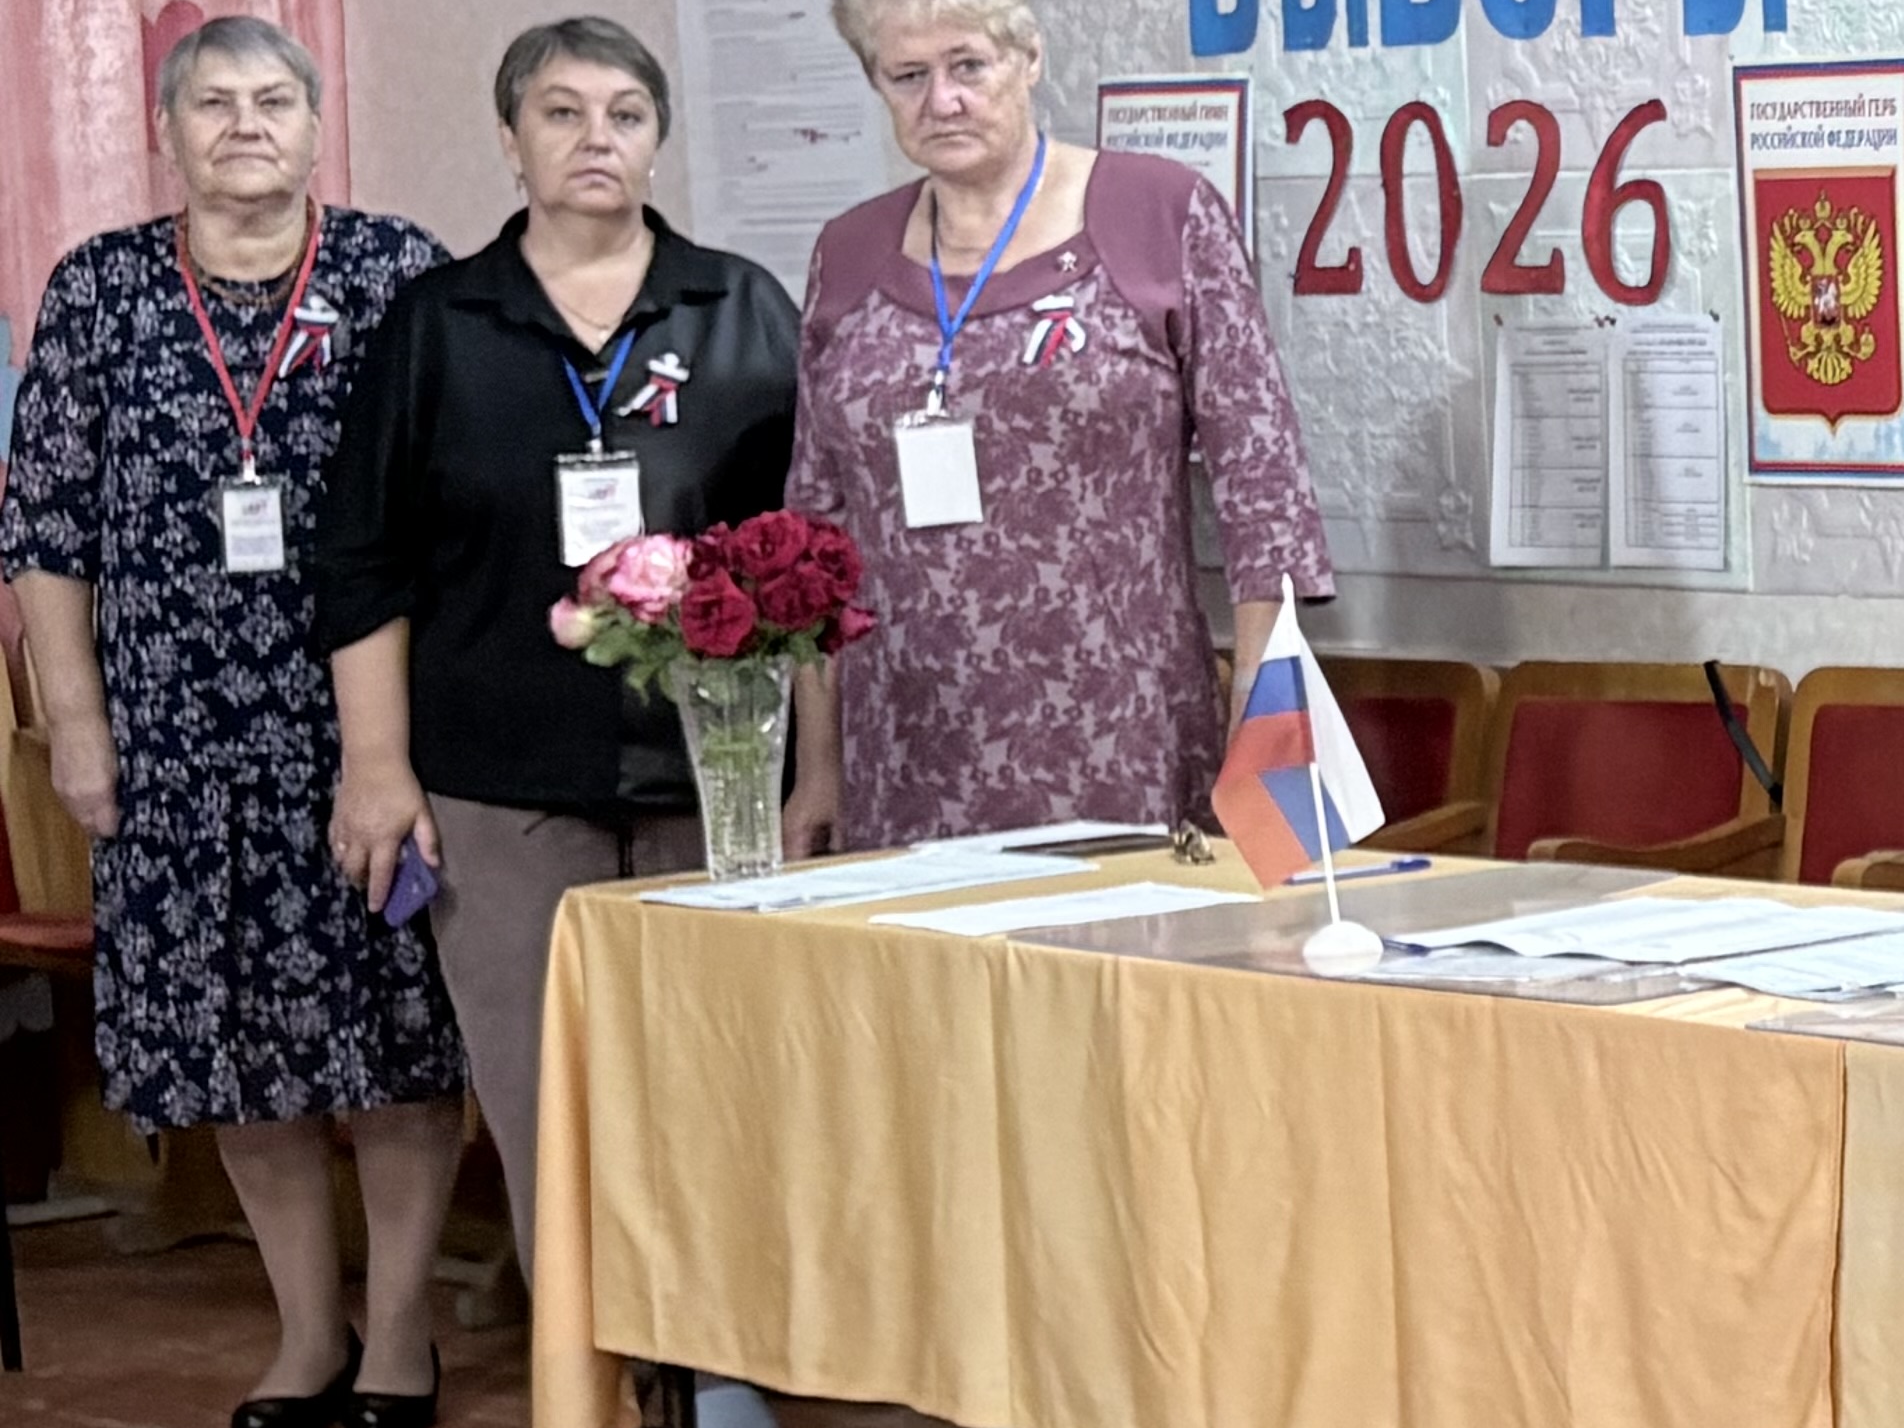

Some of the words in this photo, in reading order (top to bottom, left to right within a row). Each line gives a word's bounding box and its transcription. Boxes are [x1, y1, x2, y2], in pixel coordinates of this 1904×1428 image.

[1749, 93, 1866, 122] ГОСУДАРСТВЕННЫЙ
[1868, 98, 1897, 118] ГЕРБ
[1750, 124, 1825, 150] РОССИЙСКОЙ
[1827, 128, 1898, 152] ФЕДЕРАЦИИ
[1283, 98, 1671, 305] 2026
